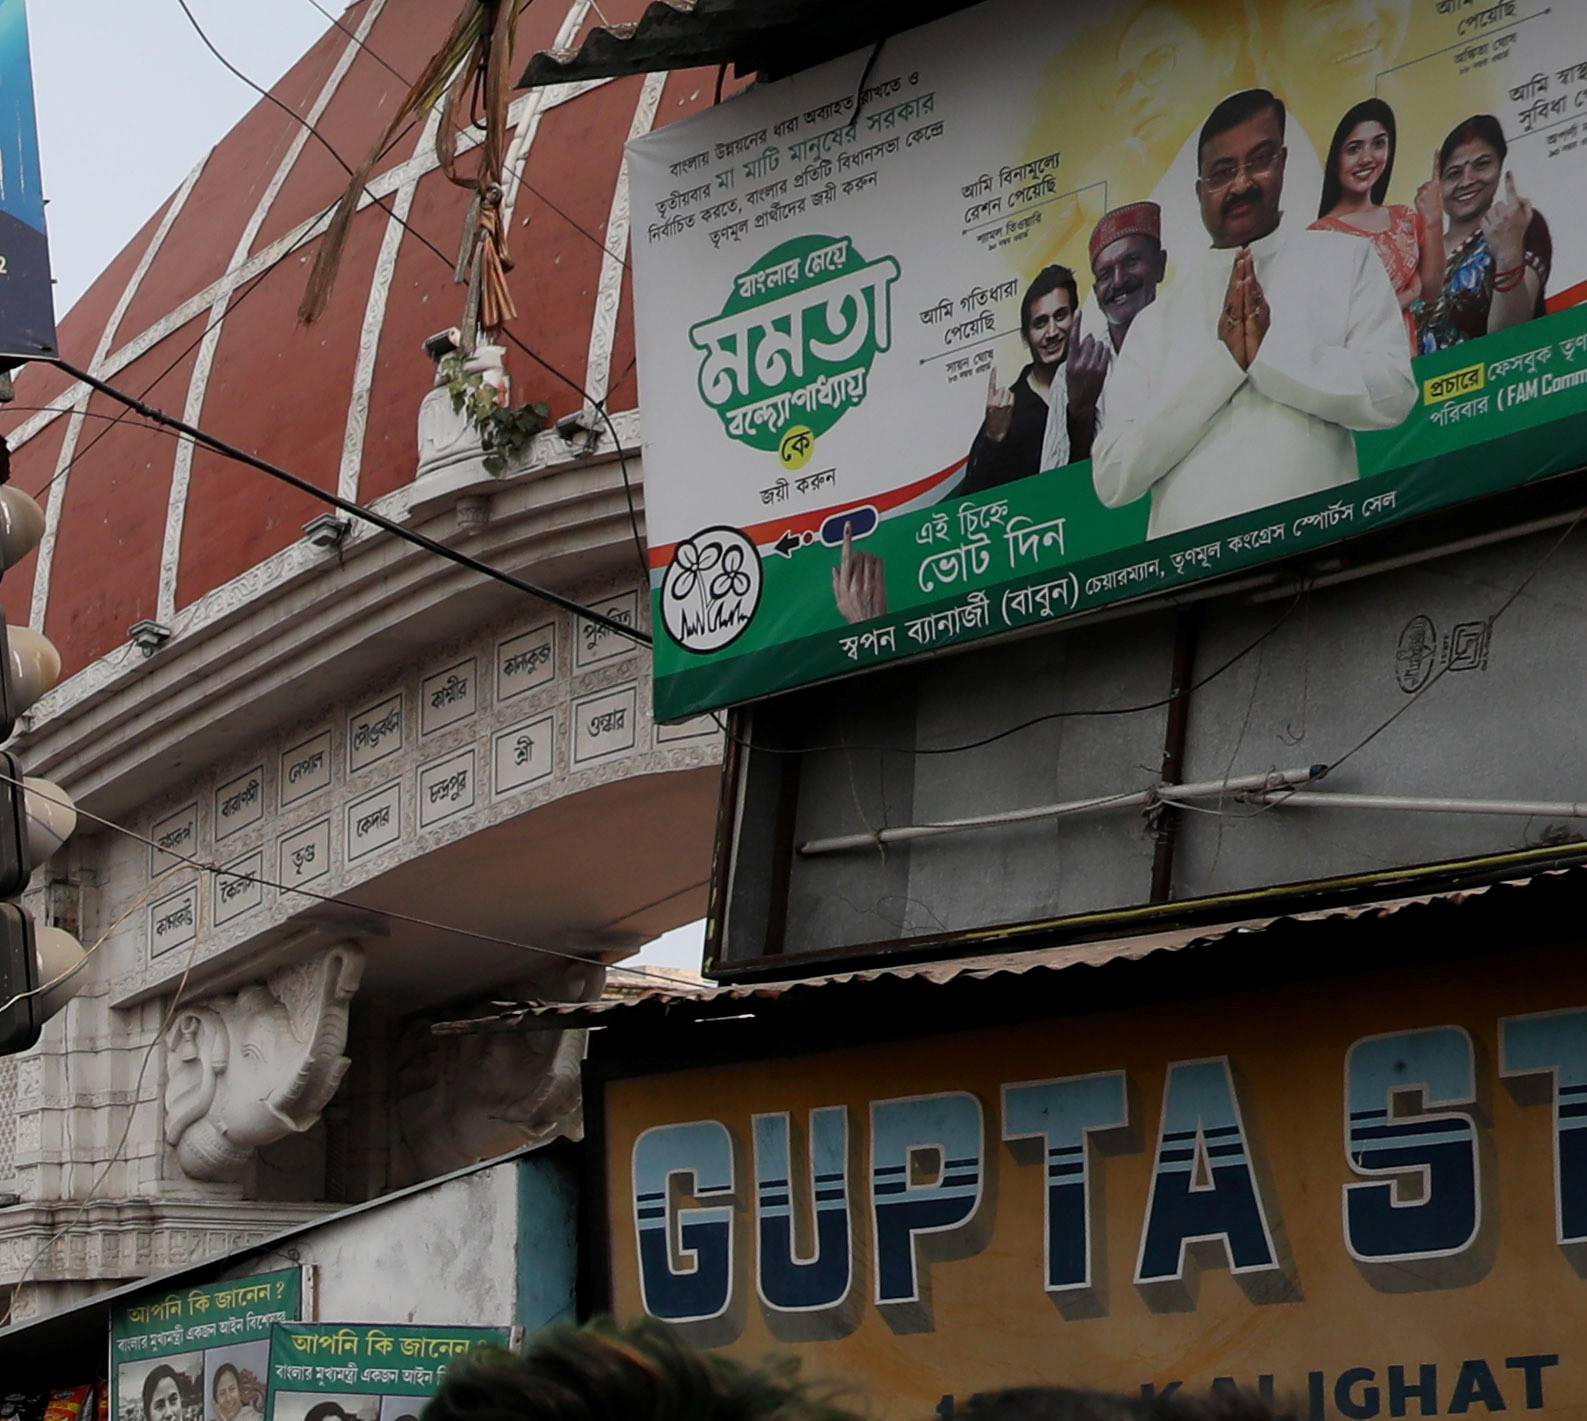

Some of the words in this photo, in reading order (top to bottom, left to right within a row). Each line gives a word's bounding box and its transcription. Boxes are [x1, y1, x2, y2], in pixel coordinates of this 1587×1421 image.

[670, 152, 710, 177] বাংলায়
[773, 118, 798, 137] ধারা
[907, 71, 920, 86] ও
[715, 167, 736, 190] মা
[743, 147, 781, 180] মাটি
[790, 122, 858, 162] মানুষের
[866, 91, 936, 132] সরকার
[746, 179, 788, 205] বাংলার
[794, 159, 833, 189] প্রতিটি
[838, 137, 901, 173] বিধানসভা
[961, 174, 993, 199] আমি
[708, 219, 749, 249] তৃণমূল
[812, 184, 837, 207] জয়ী
[842, 171, 879, 195] করুন
[964, 201, 1001, 224] রেশন
[1008, 174, 1057, 208] পেয়েছি
[738, 258, 801, 298] বাংলার
[805, 241, 849, 278] মেয়ে
[919, 298, 953, 326] আমি
[960, 277, 1019, 314] গতিধারা
[693, 259, 897, 404] মমতা
[944, 310, 996, 346] পেয়েছি
[1430, 368, 1481, 398] প্রচারে
[1487, 346, 1553, 382] ফেসবুক
[1430, 396, 1490, 427] পরিবার
[781, 431, 811, 462] কে
[760, 478, 790, 505] জয়ী
[795, 468, 837, 496] করুন
[916, 519, 949, 544] এই
[919, 537, 991, 593] ভোট
[1007, 514, 1065, 570] দিন
[840, 627, 895, 662] স্বপন
[905, 590, 991, 643] ব্যানার্জী
[1002, 574, 1078, 627] (বাবুন)
[1171, 541, 1221, 576] তৃণমূল
[1361, 491, 1398, 519] সেল
[356, 805, 391, 838] কেদার
[631, 1054, 1284, 1327] GUPTA
[129, 1294, 182, 1323] আপনি
[188, 1289, 210, 1316] কি
[214, 1283, 271, 1309] জানেন
[291, 1328, 358, 1356] আপনি
[365, 1329, 394, 1356] কি
[400, 1337, 471, 1358] জানেন
[275, 1364, 313, 1381] বাংলার
[360, 1368, 399, 1385] একজন
[402, 1366, 433, 1386] আইন
